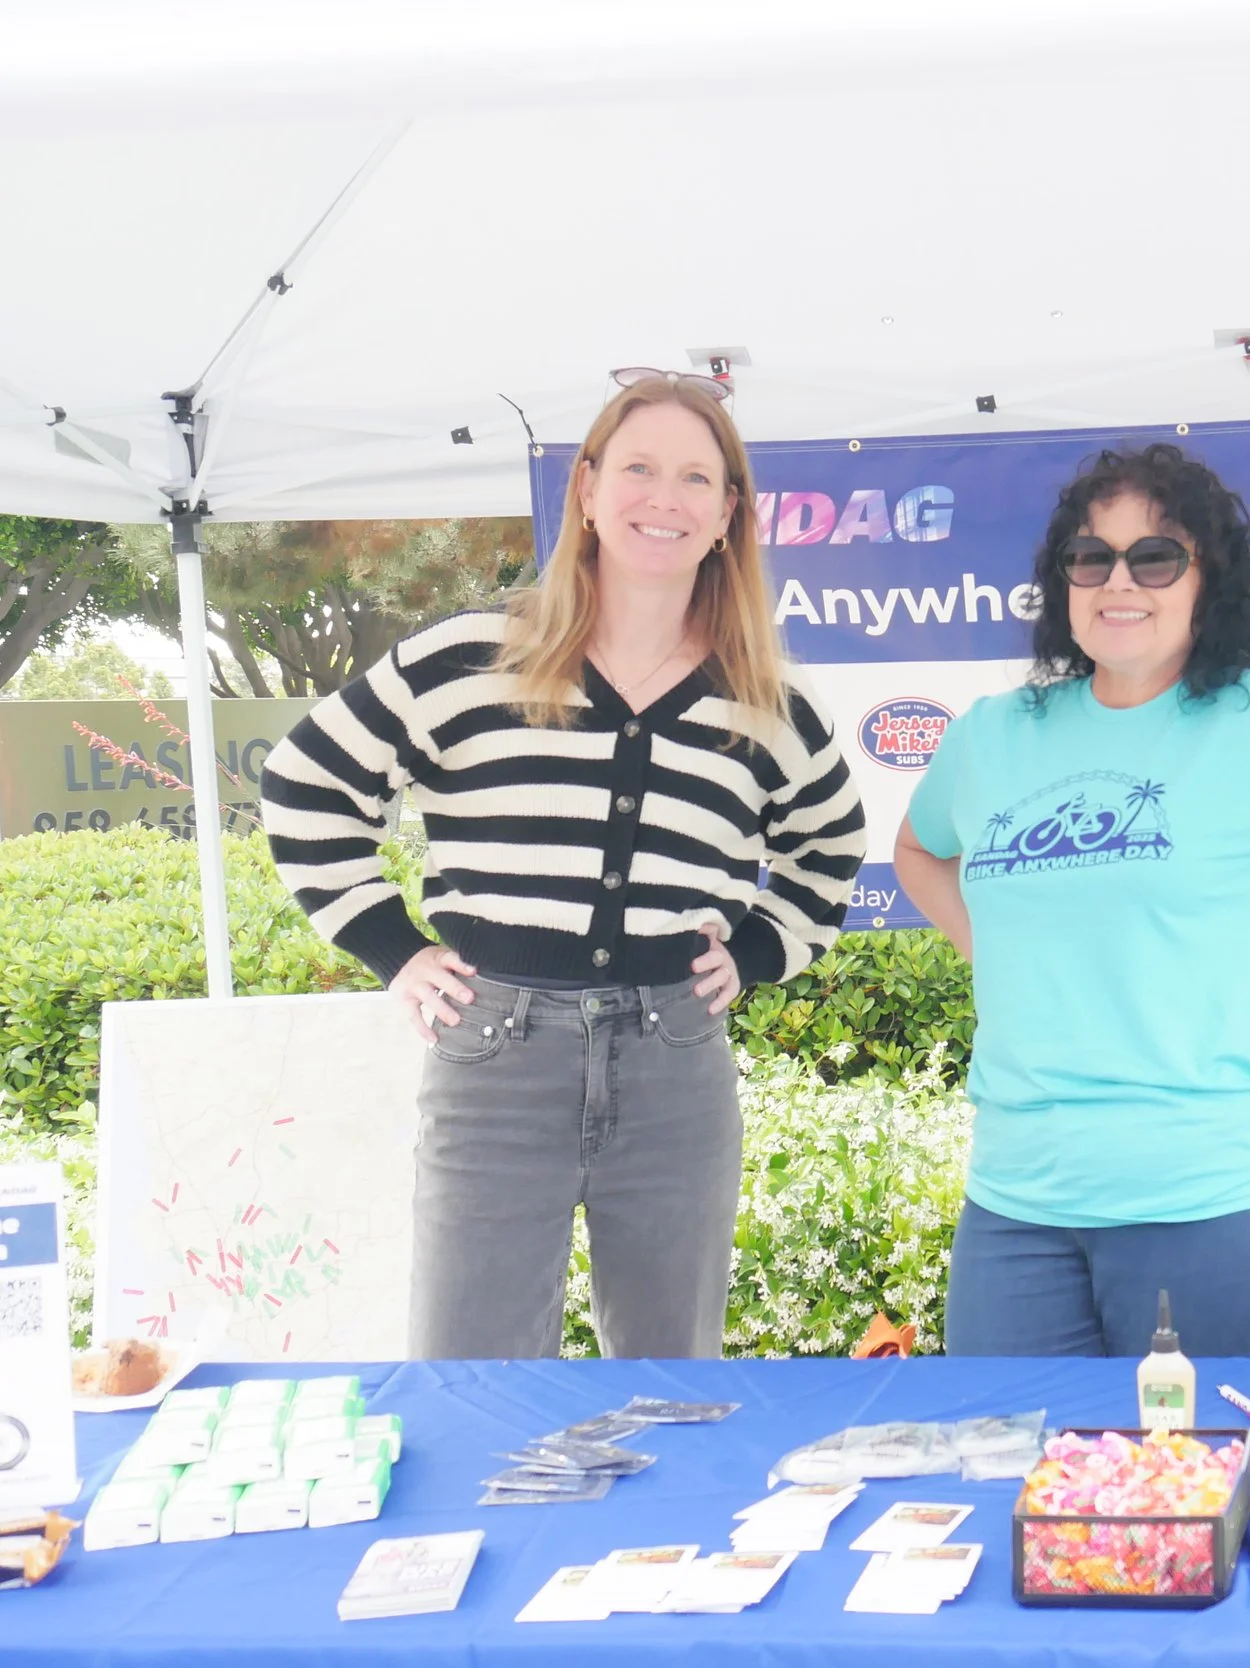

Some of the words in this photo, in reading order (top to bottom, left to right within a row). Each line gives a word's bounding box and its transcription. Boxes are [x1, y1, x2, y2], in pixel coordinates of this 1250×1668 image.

[756, 485, 955, 546] DAG
[772, 573, 1046, 636] Anywhe
[871, 711, 947, 736] Jersey
[64, 738, 275, 792] LEASNG
[896, 755, 925, 765] SUBS
[965, 862, 1008, 882] BIKE
[1009, 849, 1122, 876] ANYWHERE
[1122, 844, 1174, 862] DAY
